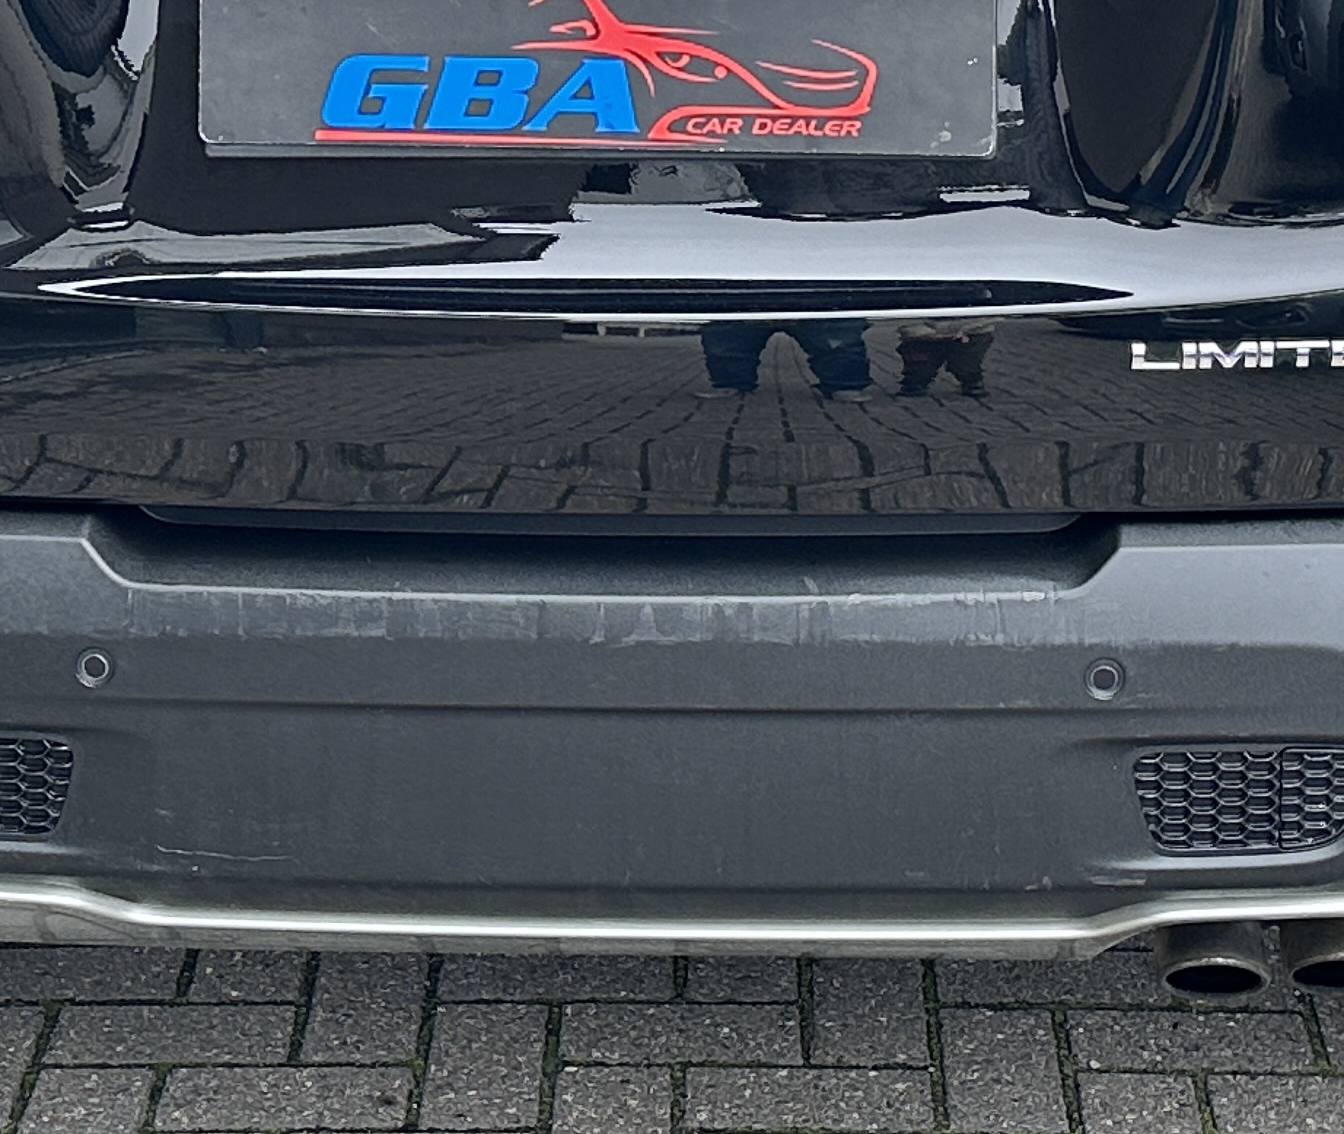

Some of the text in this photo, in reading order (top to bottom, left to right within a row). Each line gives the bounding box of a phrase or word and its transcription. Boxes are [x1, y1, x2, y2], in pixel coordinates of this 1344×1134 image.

[320, 53, 640, 133] GBA
[685, 117, 862, 137] CAR DEALER
